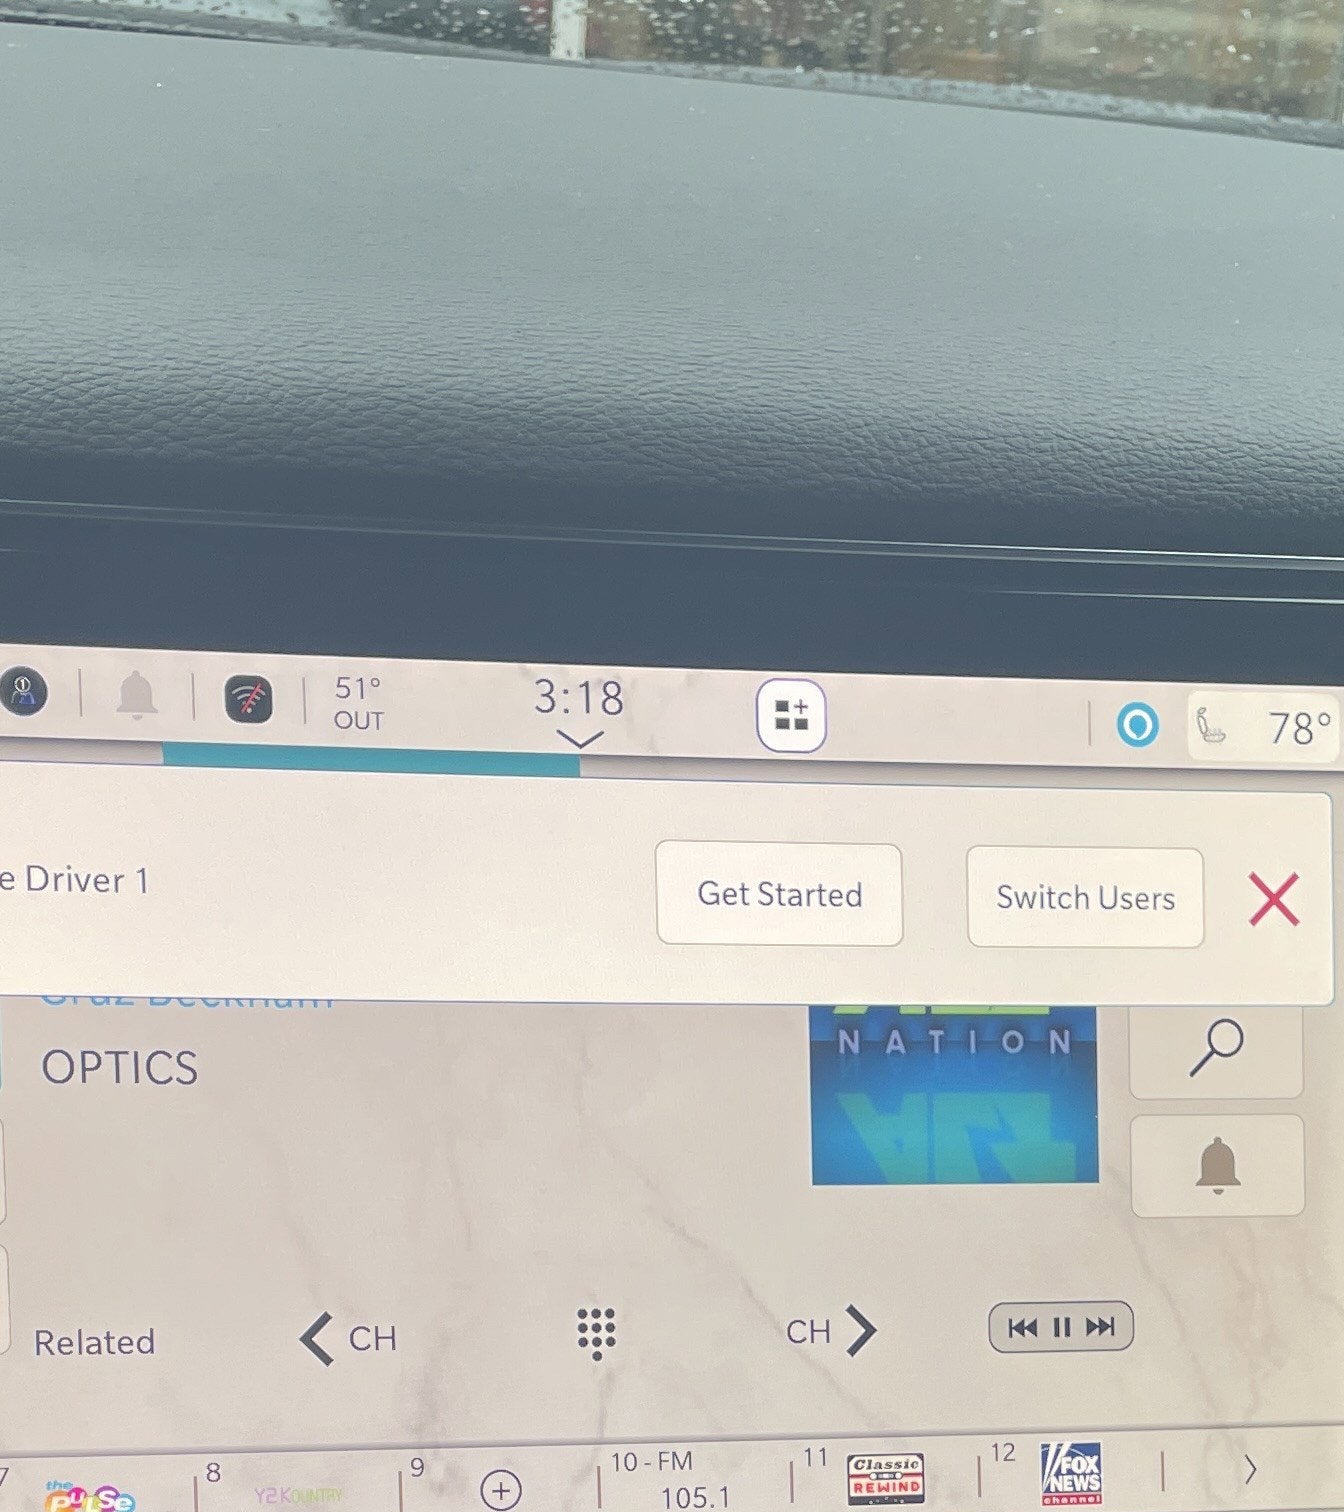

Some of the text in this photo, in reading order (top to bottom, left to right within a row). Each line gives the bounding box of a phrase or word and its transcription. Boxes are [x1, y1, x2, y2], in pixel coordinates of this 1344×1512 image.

[335, 675, 381, 700] 51°
[535, 678, 624, 716] 3:18
[333, 710, 385, 731] OUT
[1269, 711, 1331, 745] 78°
[26, 864, 125, 894] Driver
[135, 867, 148, 894] 1
[697, 880, 863, 908] Get Started
[996, 883, 1175, 911] Switch Users
[839, 1028, 1072, 1055] NATION
[42, 1048, 198, 1086] OPTICS
[34, 1328, 155, 1357] Related
[348, 1325, 397, 1353] CH
[786, 1318, 830, 1344] CH
[804, 1446, 827, 1467] 11
[853, 1457, 920, 1471] Classic
[990, 1442, 1016, 1462] 12
[1060, 1455, 1100, 1474] FOX
[206, 1462, 221, 1483] 8
[410, 1457, 425, 1478] 9
[45, 1480, 73, 1491] the
[853, 1481, 921, 1494] REWIND
[1049, 1474, 1101, 1493] NEWS
[661, 1485, 729, 1510] 105.1
[1043, 1495, 1101, 1505] channel
